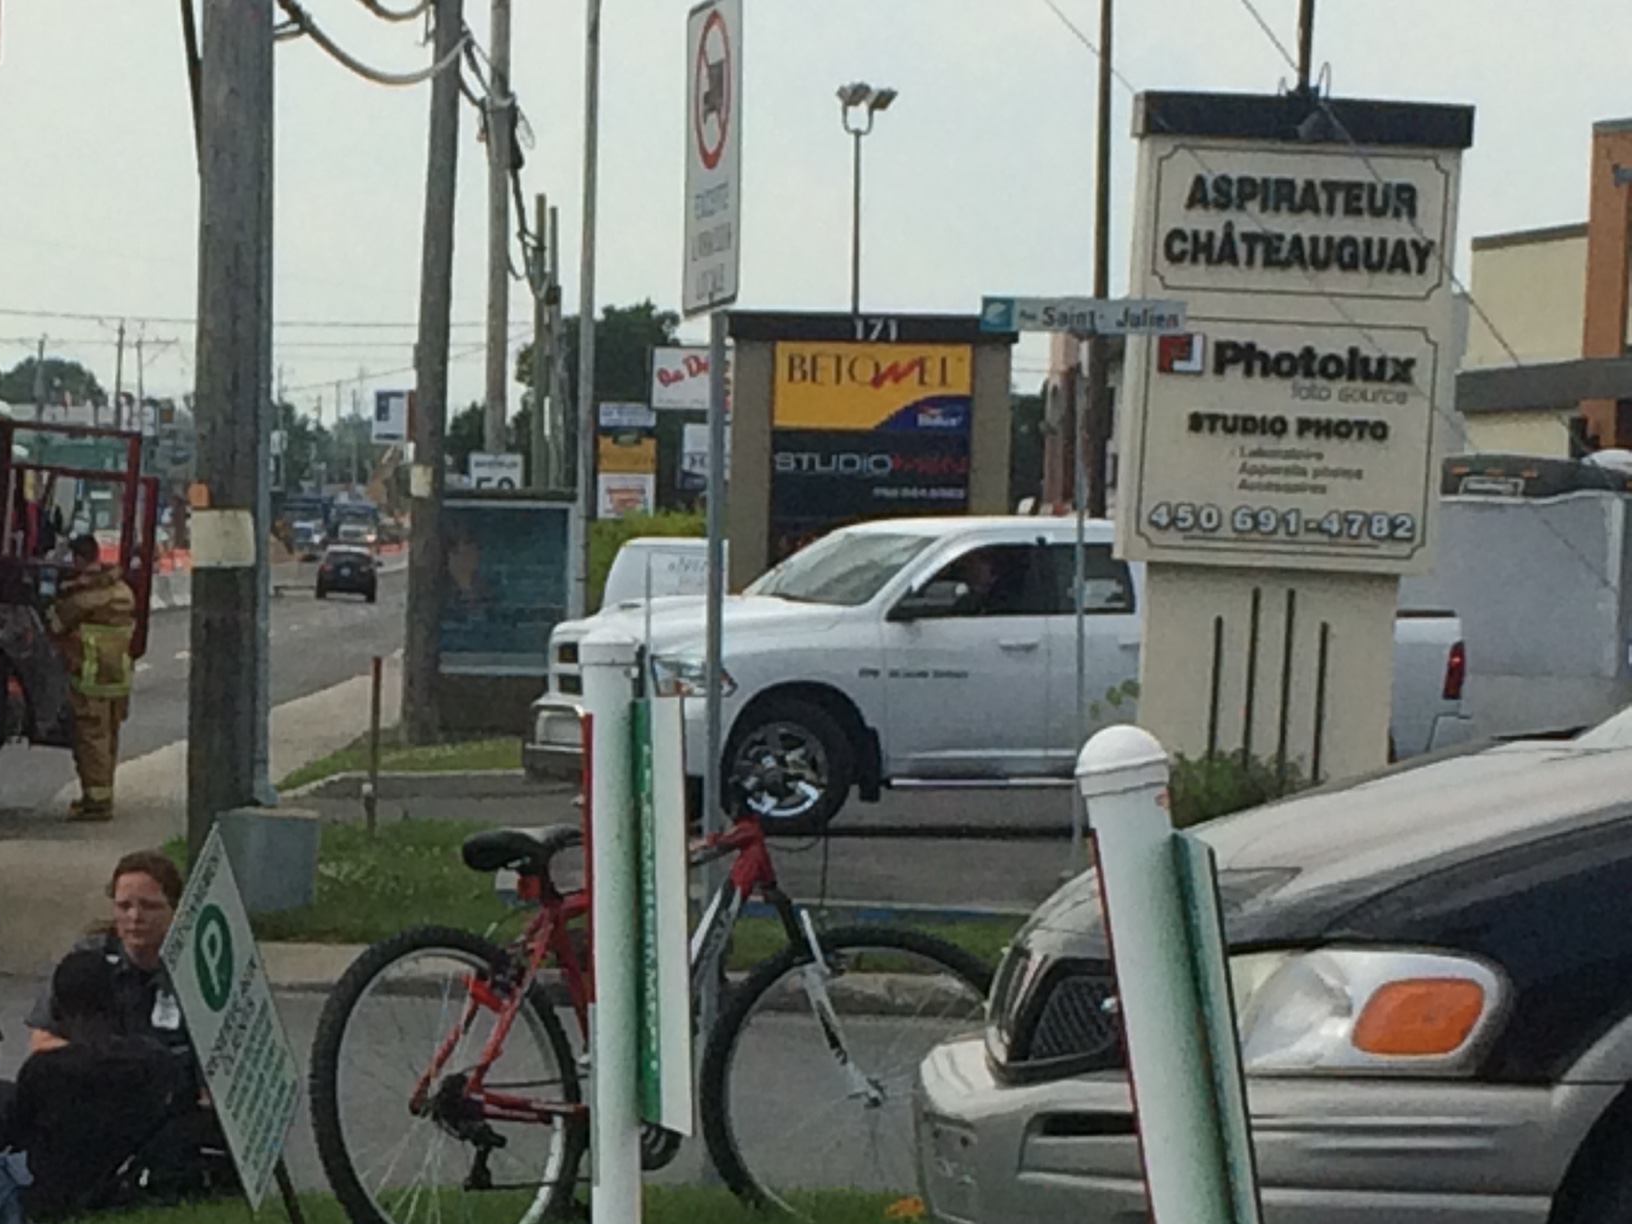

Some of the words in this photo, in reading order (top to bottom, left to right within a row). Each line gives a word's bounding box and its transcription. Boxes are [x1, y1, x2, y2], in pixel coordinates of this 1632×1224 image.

[1185, 173, 1417, 219] ASPIRATEUR
[854, 318, 899, 341] 171
[1214, 340, 1416, 383] Photolux
[1188, 411, 1288, 437] STUDIO
[1297, 416, 1389, 441] PHOTO
[774, 452, 892, 474] STUDIO
[1149, 501, 1222, 532] 450
[1232, 505, 1416, 541] 691-4782
